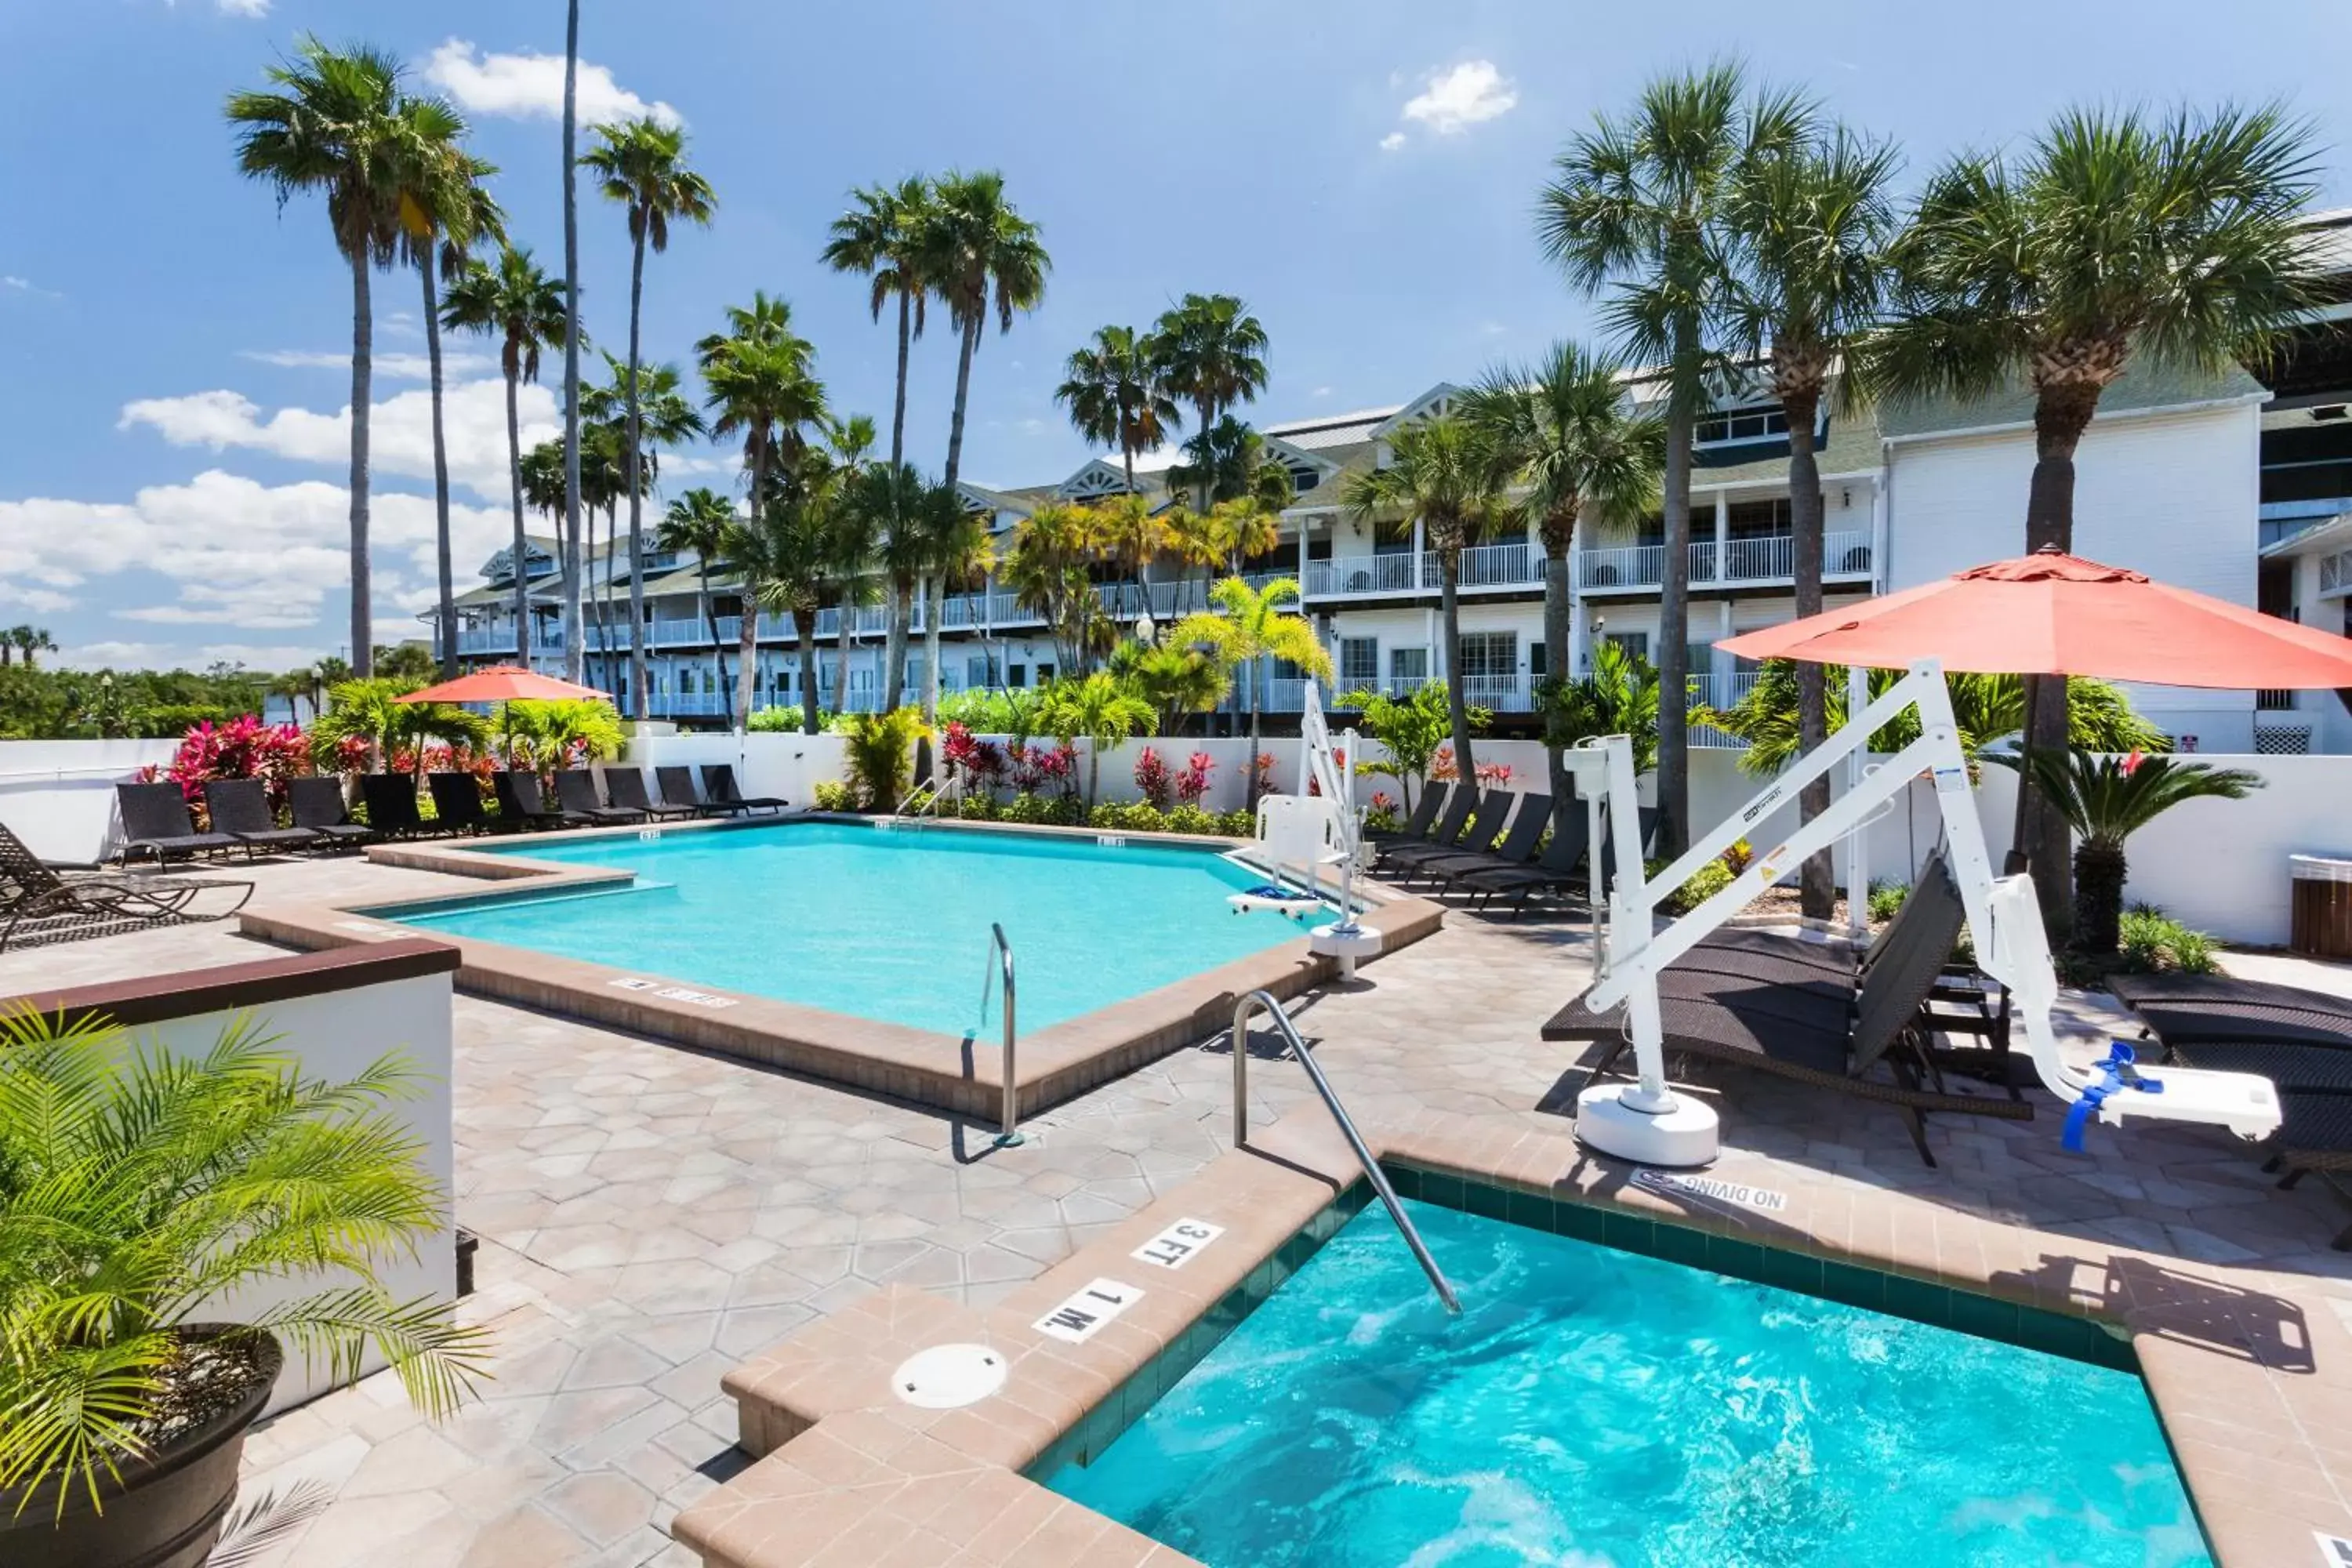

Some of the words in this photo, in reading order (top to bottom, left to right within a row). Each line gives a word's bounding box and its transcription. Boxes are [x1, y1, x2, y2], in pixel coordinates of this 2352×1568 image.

[1684, 1177, 1749, 1202] DIVING
[1755, 1191, 1781, 1208] NO
[1176, 1225, 1210, 1240] 3
[1144, 1239, 1192, 1265] FT
[1087, 1290, 1123, 1305] 1
